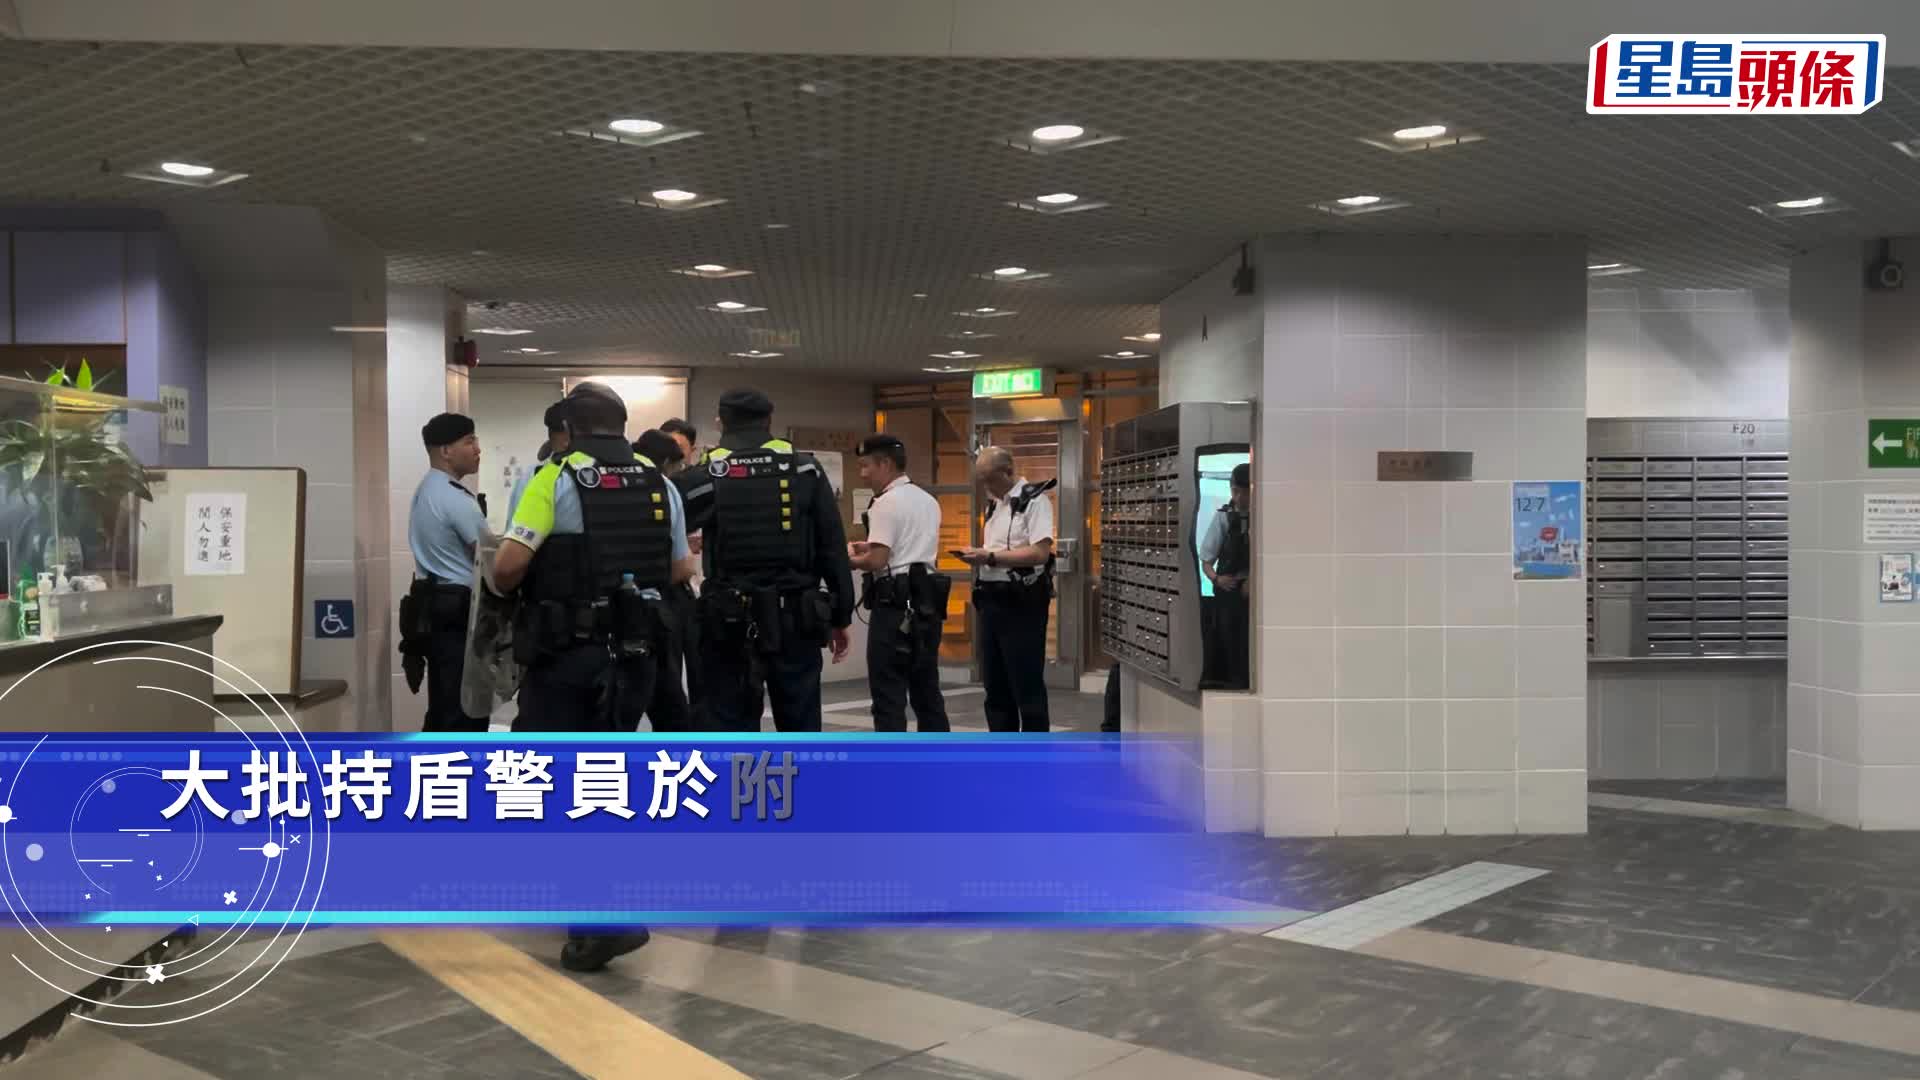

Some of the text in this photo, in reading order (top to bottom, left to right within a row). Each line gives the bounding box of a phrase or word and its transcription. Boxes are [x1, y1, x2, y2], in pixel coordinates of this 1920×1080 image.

[1733, 423, 1755, 434] F20
[739, 457, 764, 465] POLICE
[607, 466, 634, 474] POLICE
